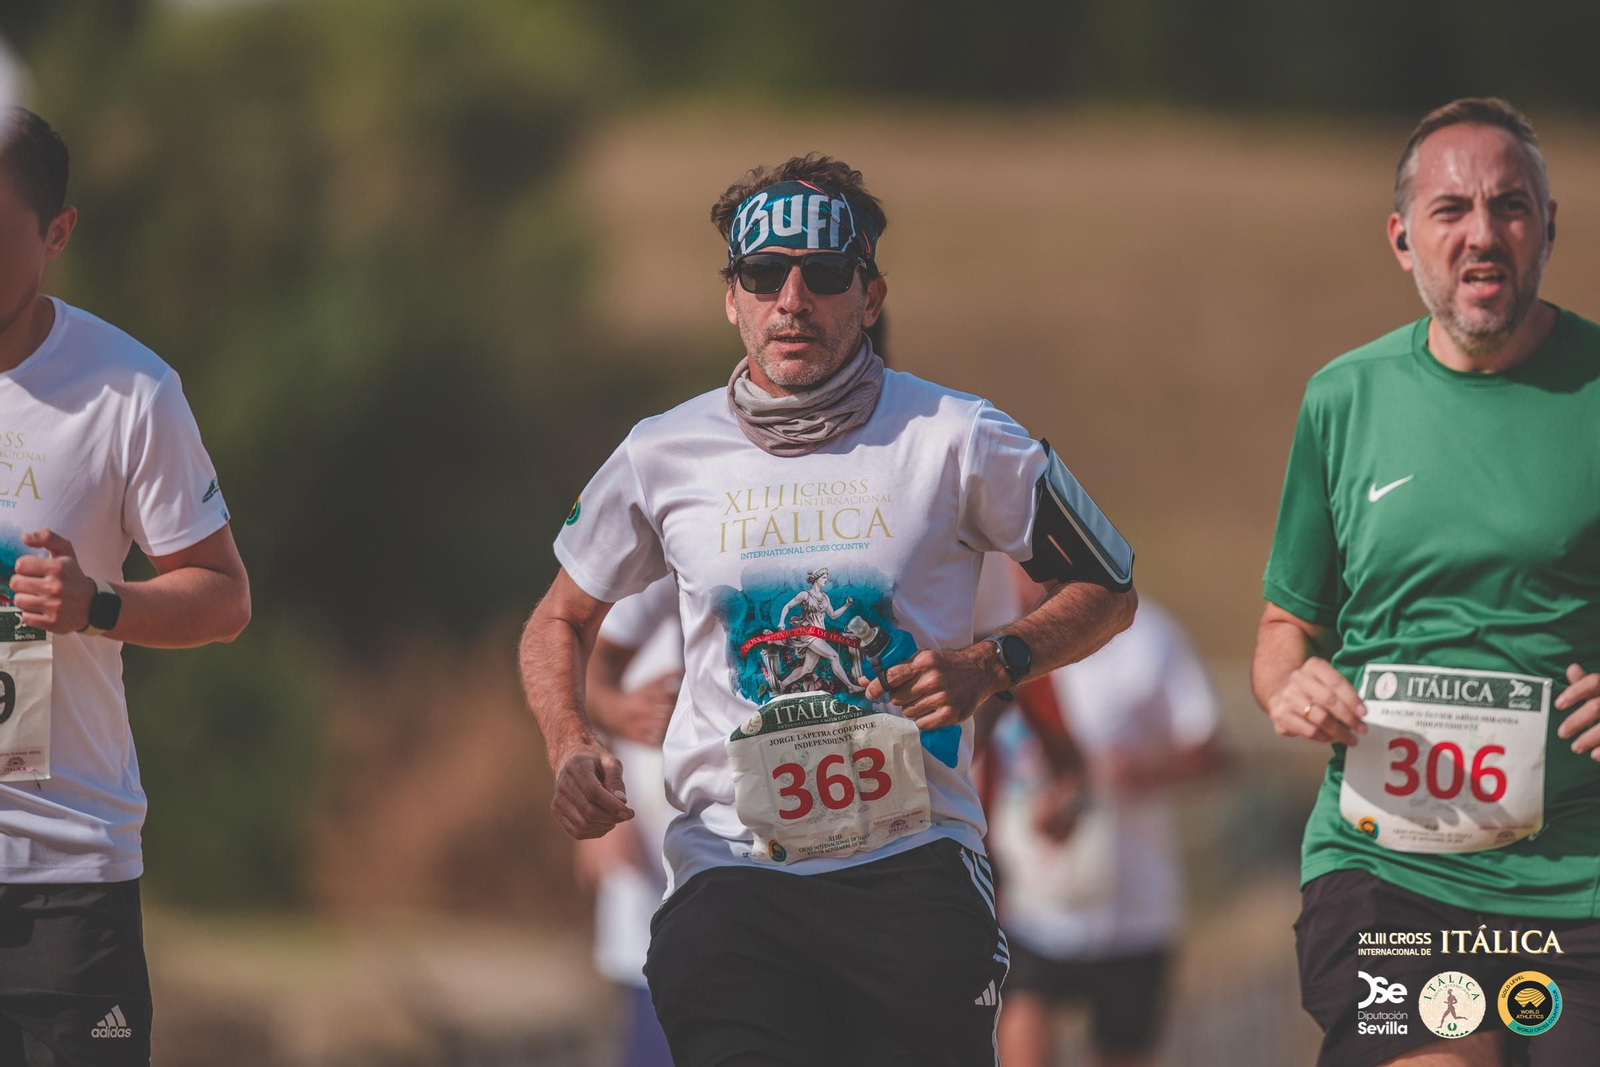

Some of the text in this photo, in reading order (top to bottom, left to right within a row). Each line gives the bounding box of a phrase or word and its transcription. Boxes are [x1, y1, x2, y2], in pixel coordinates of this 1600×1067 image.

[800, 479, 868, 498] CROSS
[800, 494, 894, 507] INTERNACIONAL
[719, 505, 894, 553] ITÁLICA
[740, 542, 870, 560] INTERNATIONAL CROSS COUNTRY
[1406, 674, 1494, 703] ITÁLICA
[769, 721, 876, 747] JORGE LAPETRA CODERQUE
[794, 733, 854, 750] INDEPENDIENTE
[1384, 737, 1508, 804] 306
[772, 747, 892, 820] 363
[91, 1025, 132, 1039] adidas
